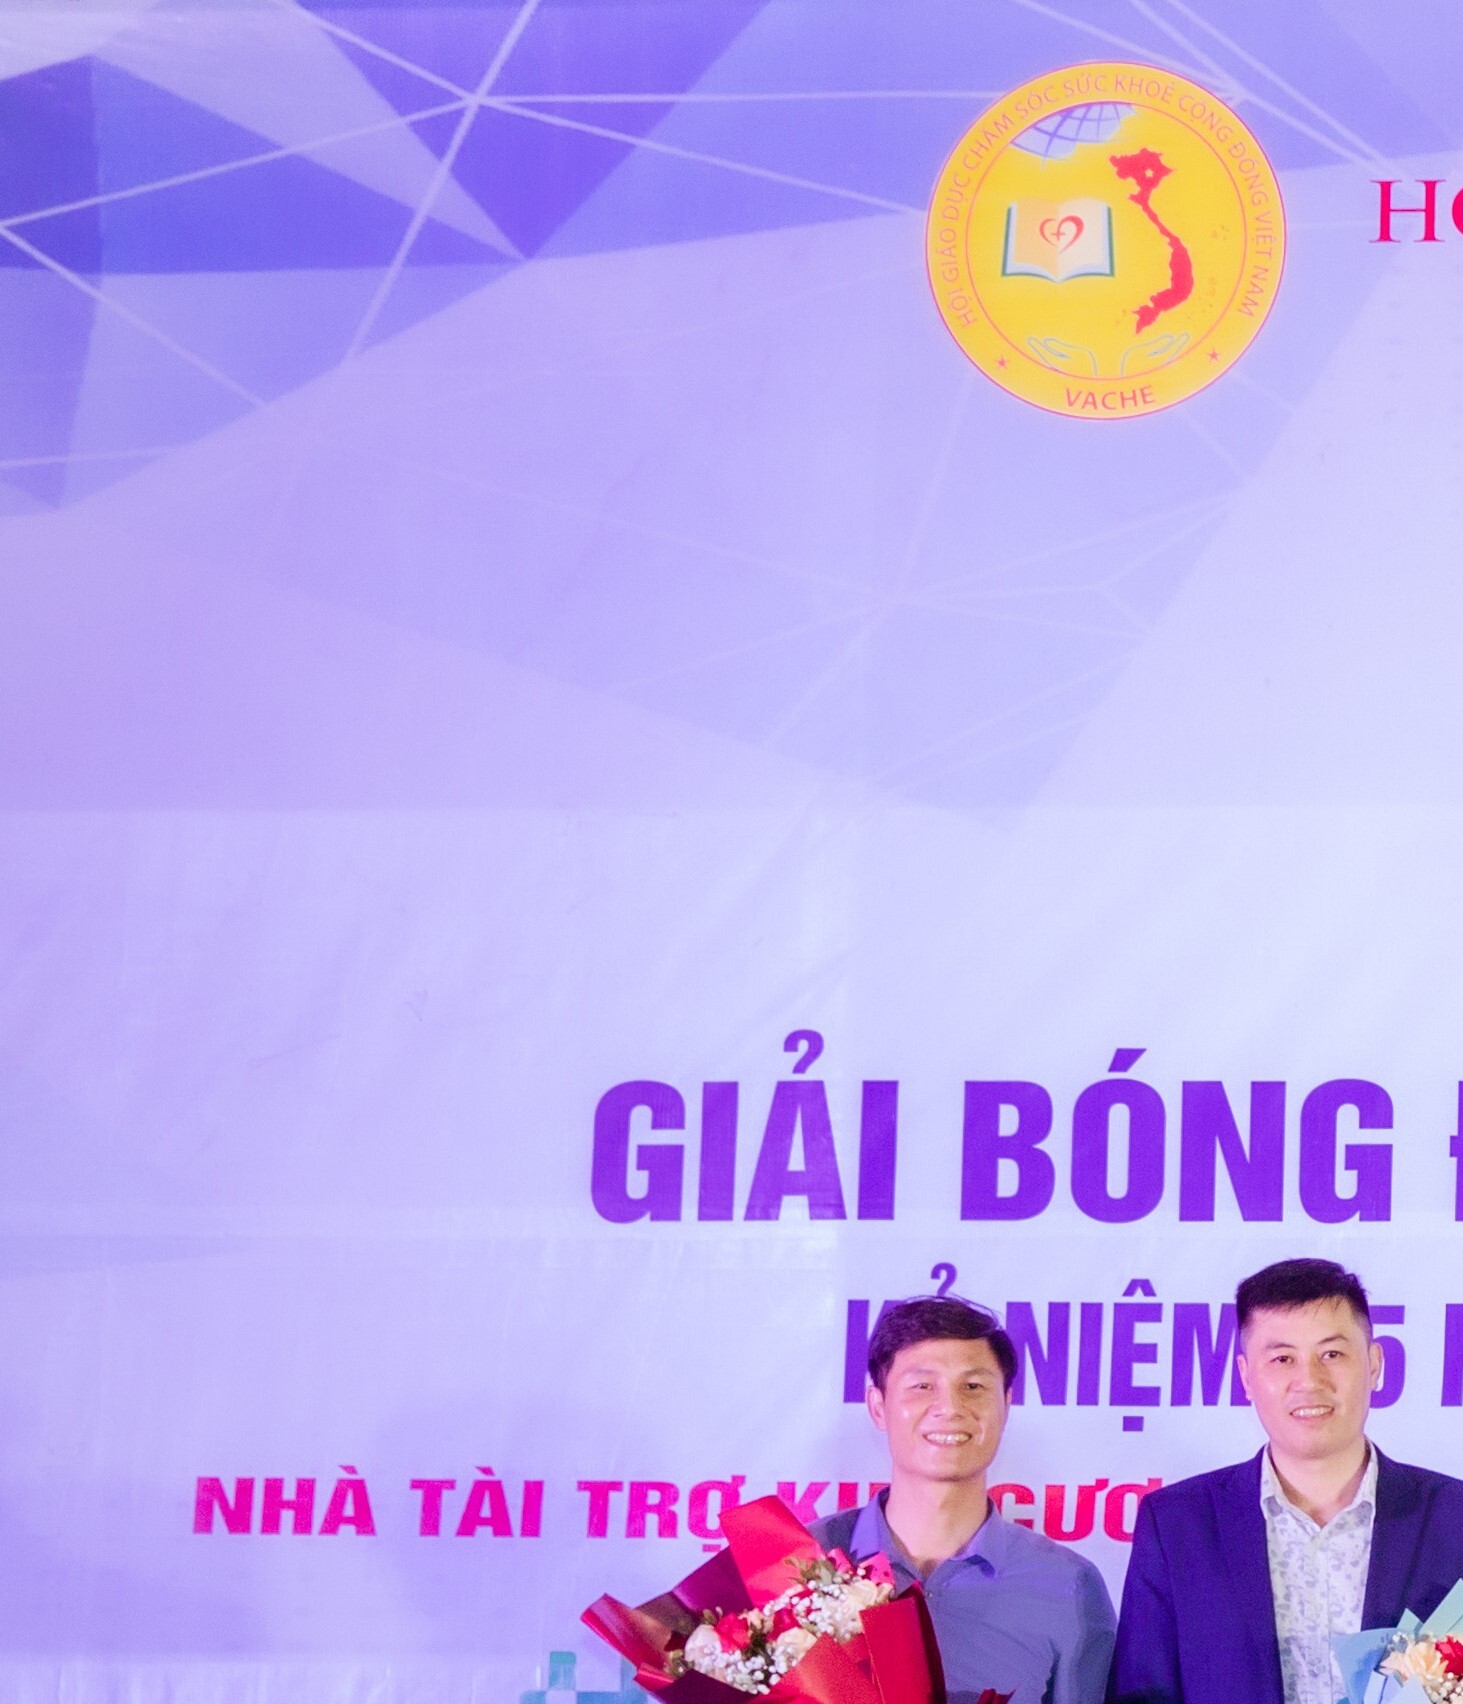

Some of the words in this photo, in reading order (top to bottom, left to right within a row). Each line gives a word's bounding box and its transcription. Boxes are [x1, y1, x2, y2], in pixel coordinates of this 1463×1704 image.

[1065, 384, 1156, 411] VACHE
[589, 1029, 898, 1224] GIẢI
[959, 1047, 1395, 1224] BÓNG
[192, 1464, 377, 1537] NHÀ
[409, 1466, 545, 1539] TÀI
[577, 1475, 747, 1553] TRỢ
